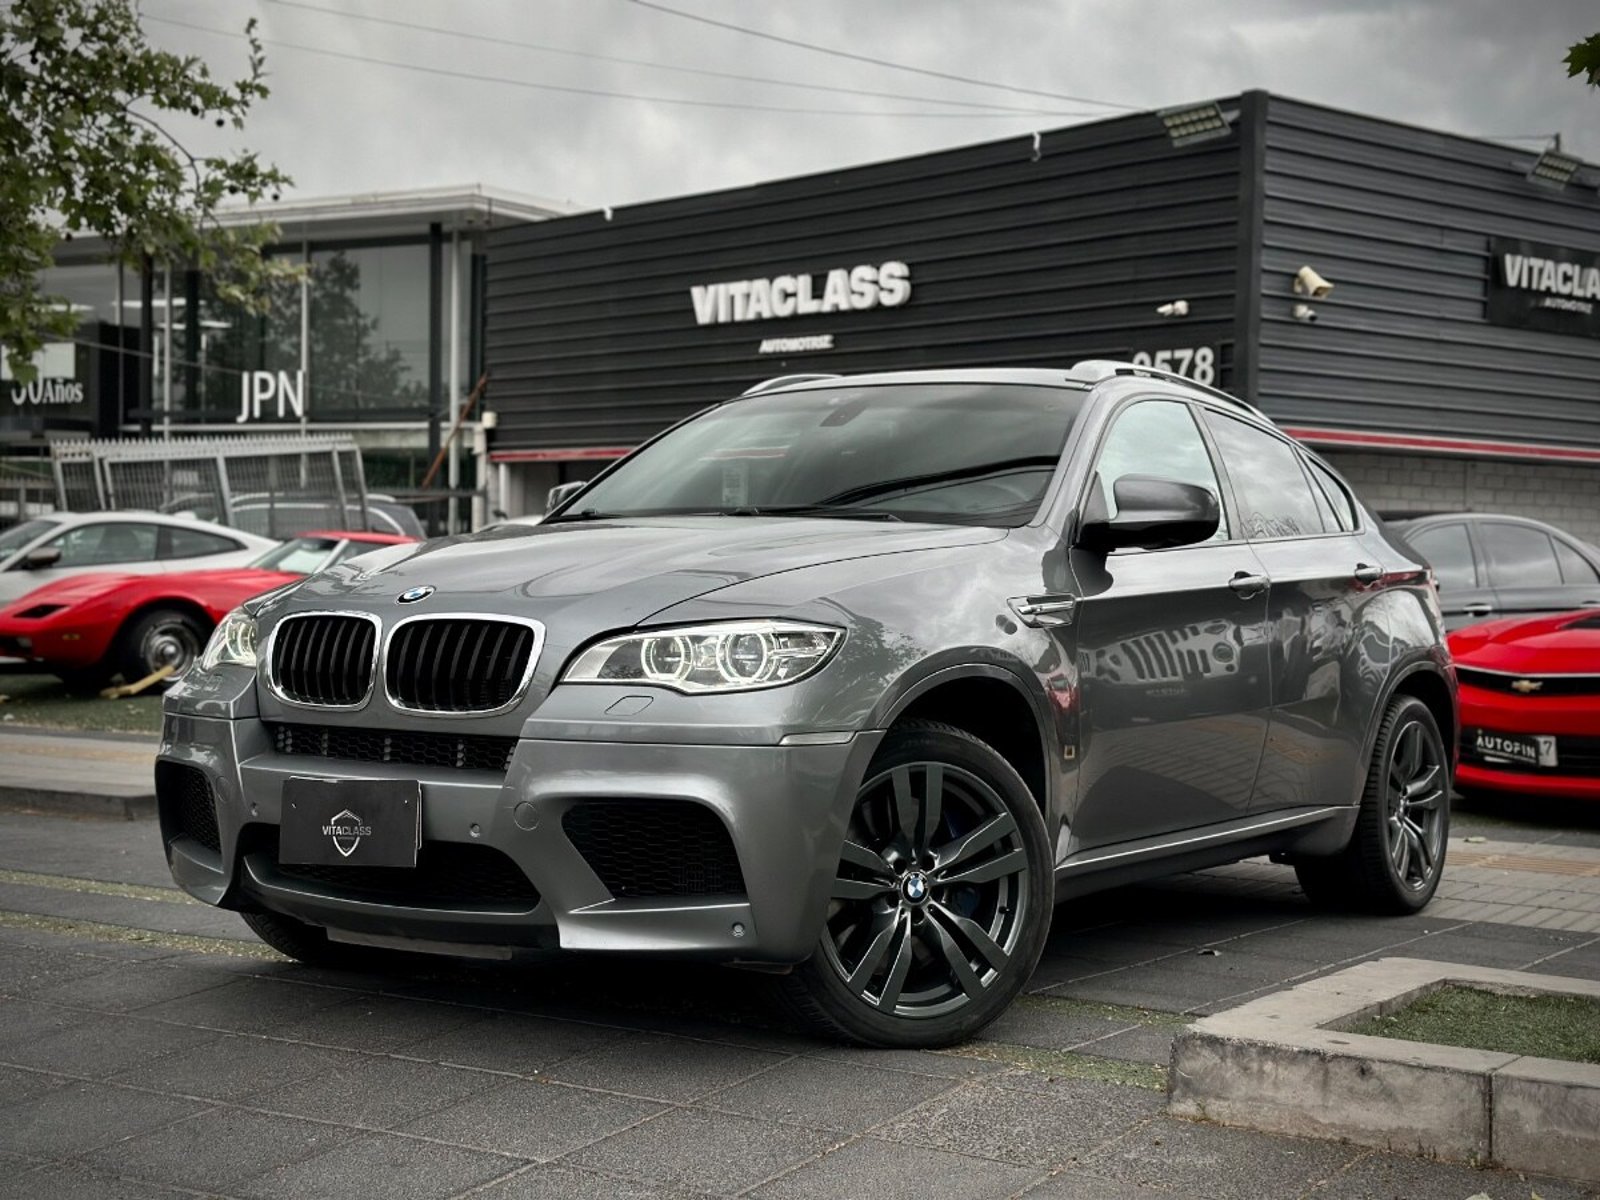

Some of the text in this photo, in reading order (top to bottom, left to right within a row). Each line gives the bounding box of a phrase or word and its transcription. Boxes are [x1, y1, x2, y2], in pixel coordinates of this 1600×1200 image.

[690, 260, 912, 325] VITACLASS
[1504, 252, 1600, 301] VITACLA
[236, 370, 304, 423] JPN
[1476, 735, 1536, 758] AUTOFIN
[322, 825, 372, 836] VITACLASS
